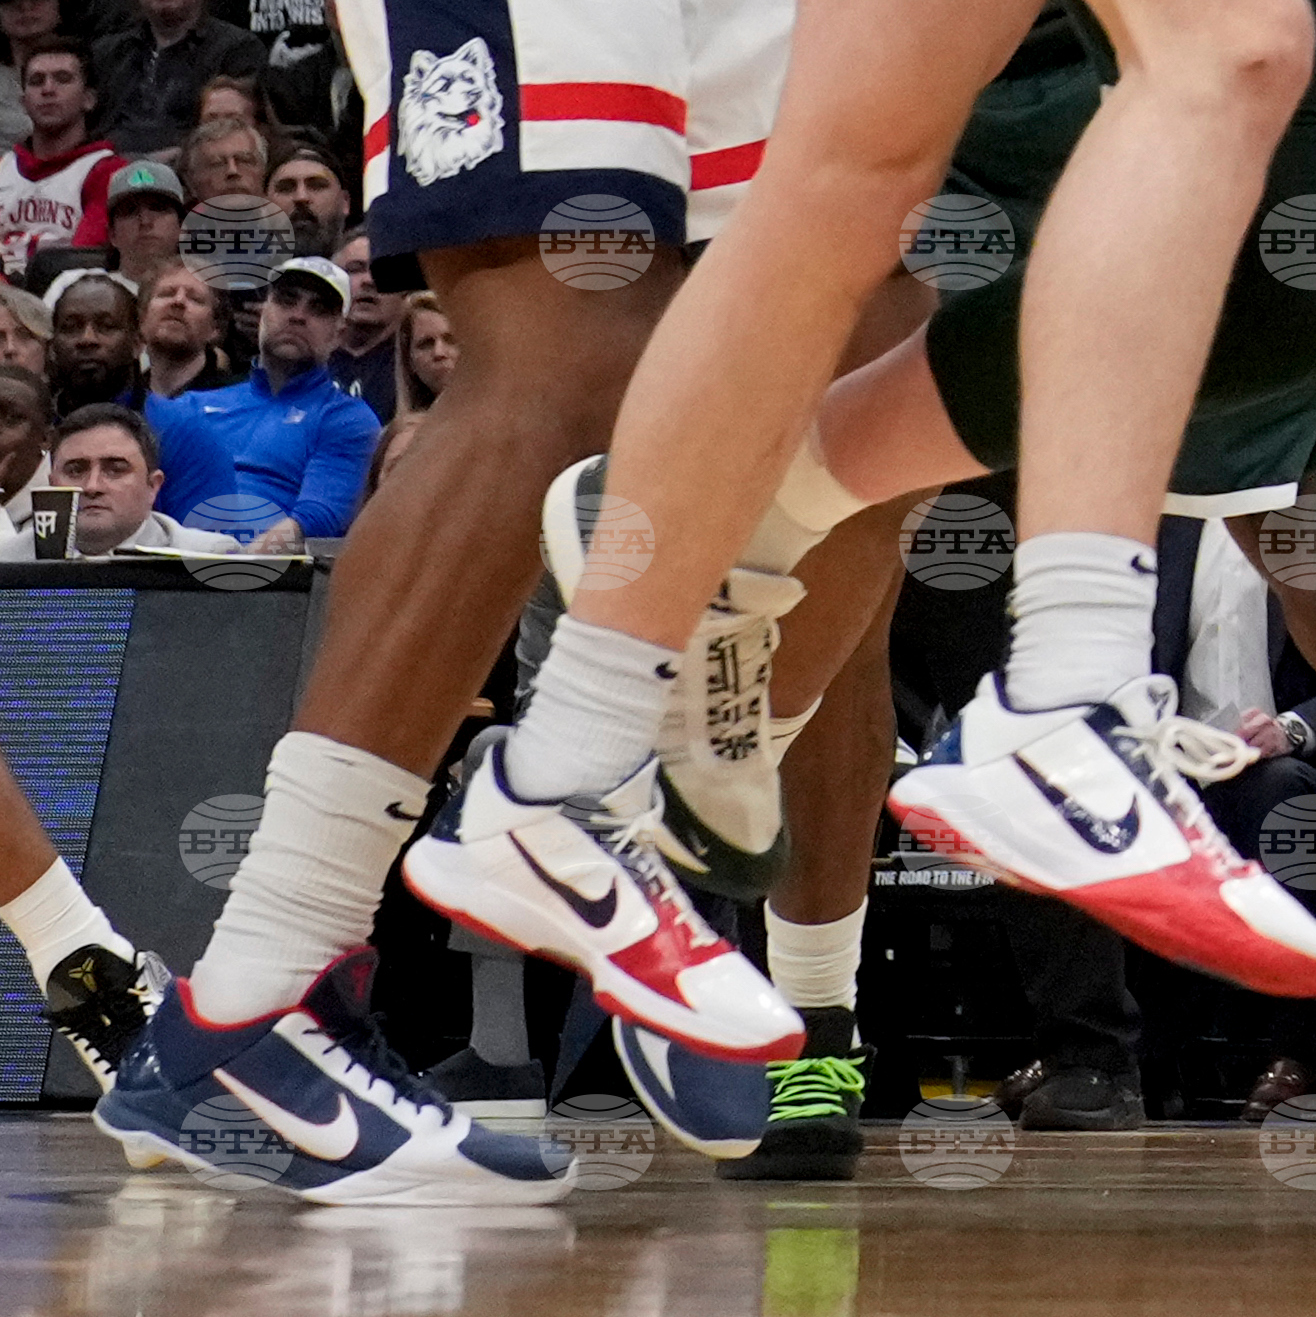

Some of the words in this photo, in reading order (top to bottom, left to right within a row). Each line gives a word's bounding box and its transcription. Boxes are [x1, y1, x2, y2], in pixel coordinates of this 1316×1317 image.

[875, 870, 898, 885] THE
[898, 870, 931, 885] ROAD
[932, 870, 948, 885] TO
[950, 870, 974, 885] THE
